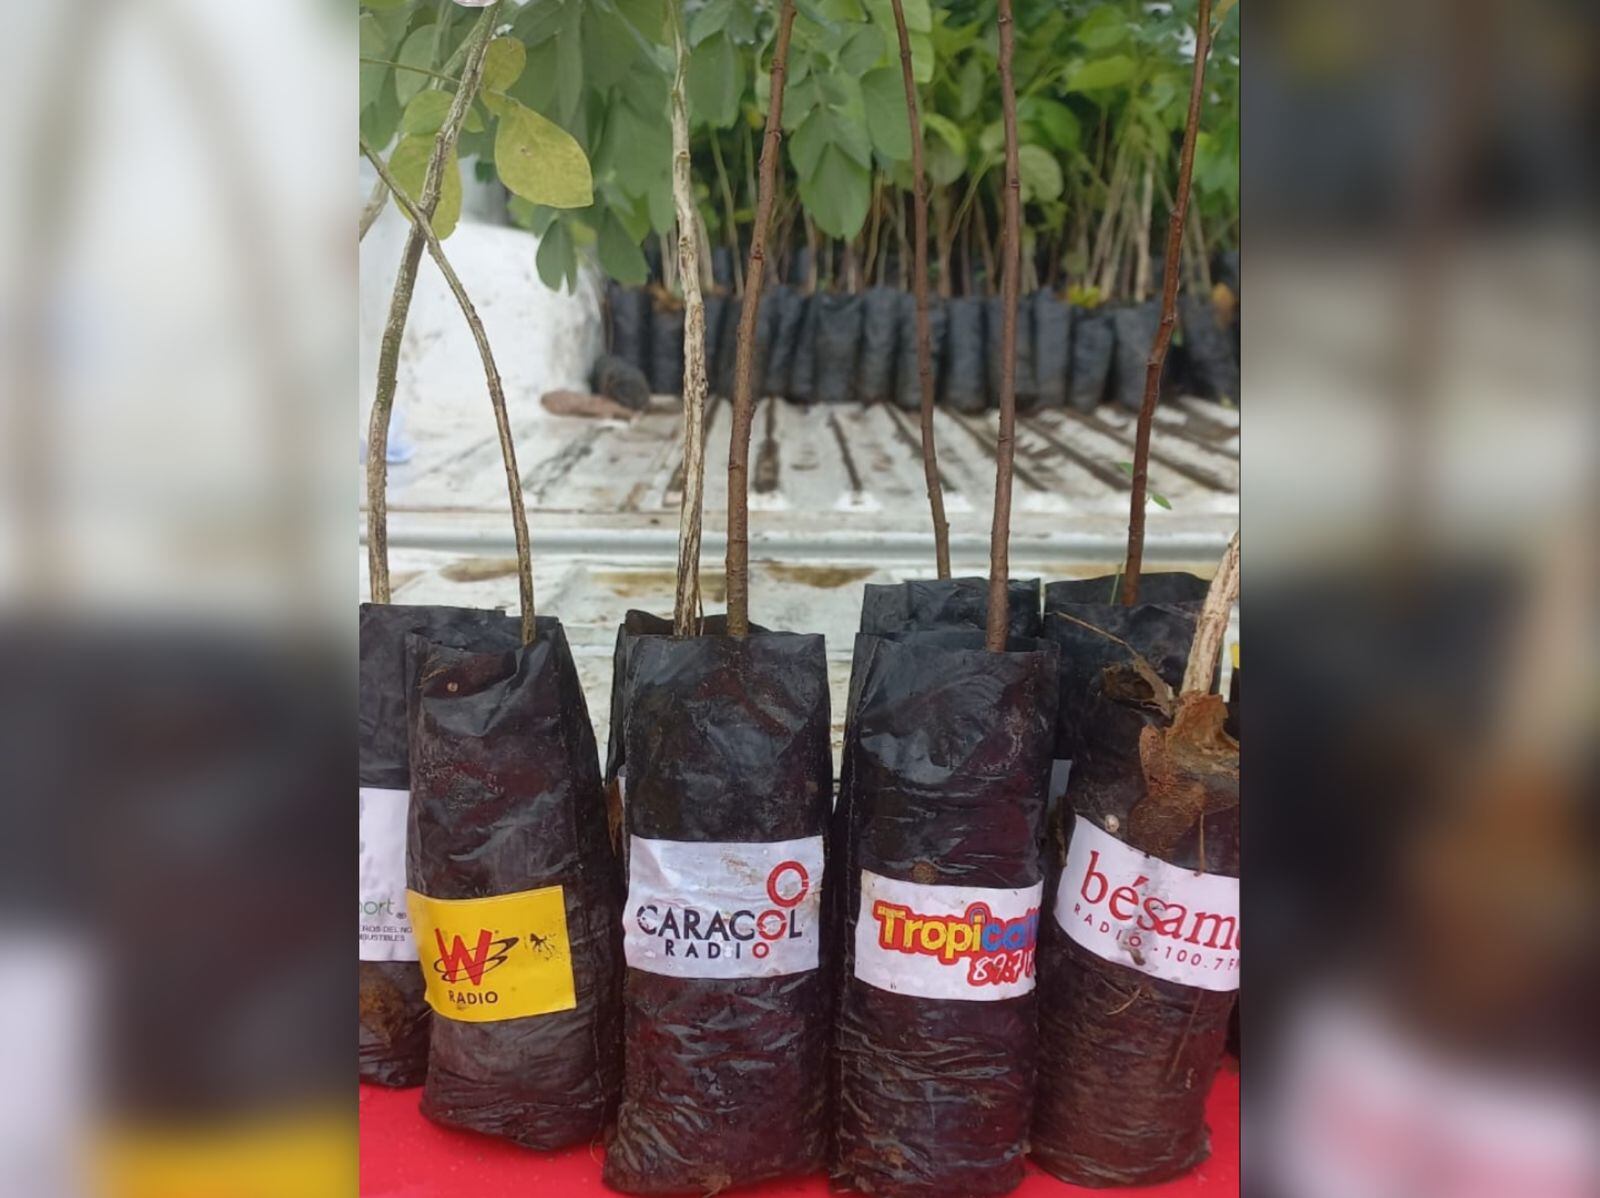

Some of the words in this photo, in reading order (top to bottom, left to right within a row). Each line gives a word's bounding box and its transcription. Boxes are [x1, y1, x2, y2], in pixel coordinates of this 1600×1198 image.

[1081, 850, 1239, 951] bésam
[636, 905, 803, 941] CARACOL
[1073, 903, 1143, 948] RADIO
[665, 939, 770, 959] RADIO
[448, 990, 498, 1005] RADIO
